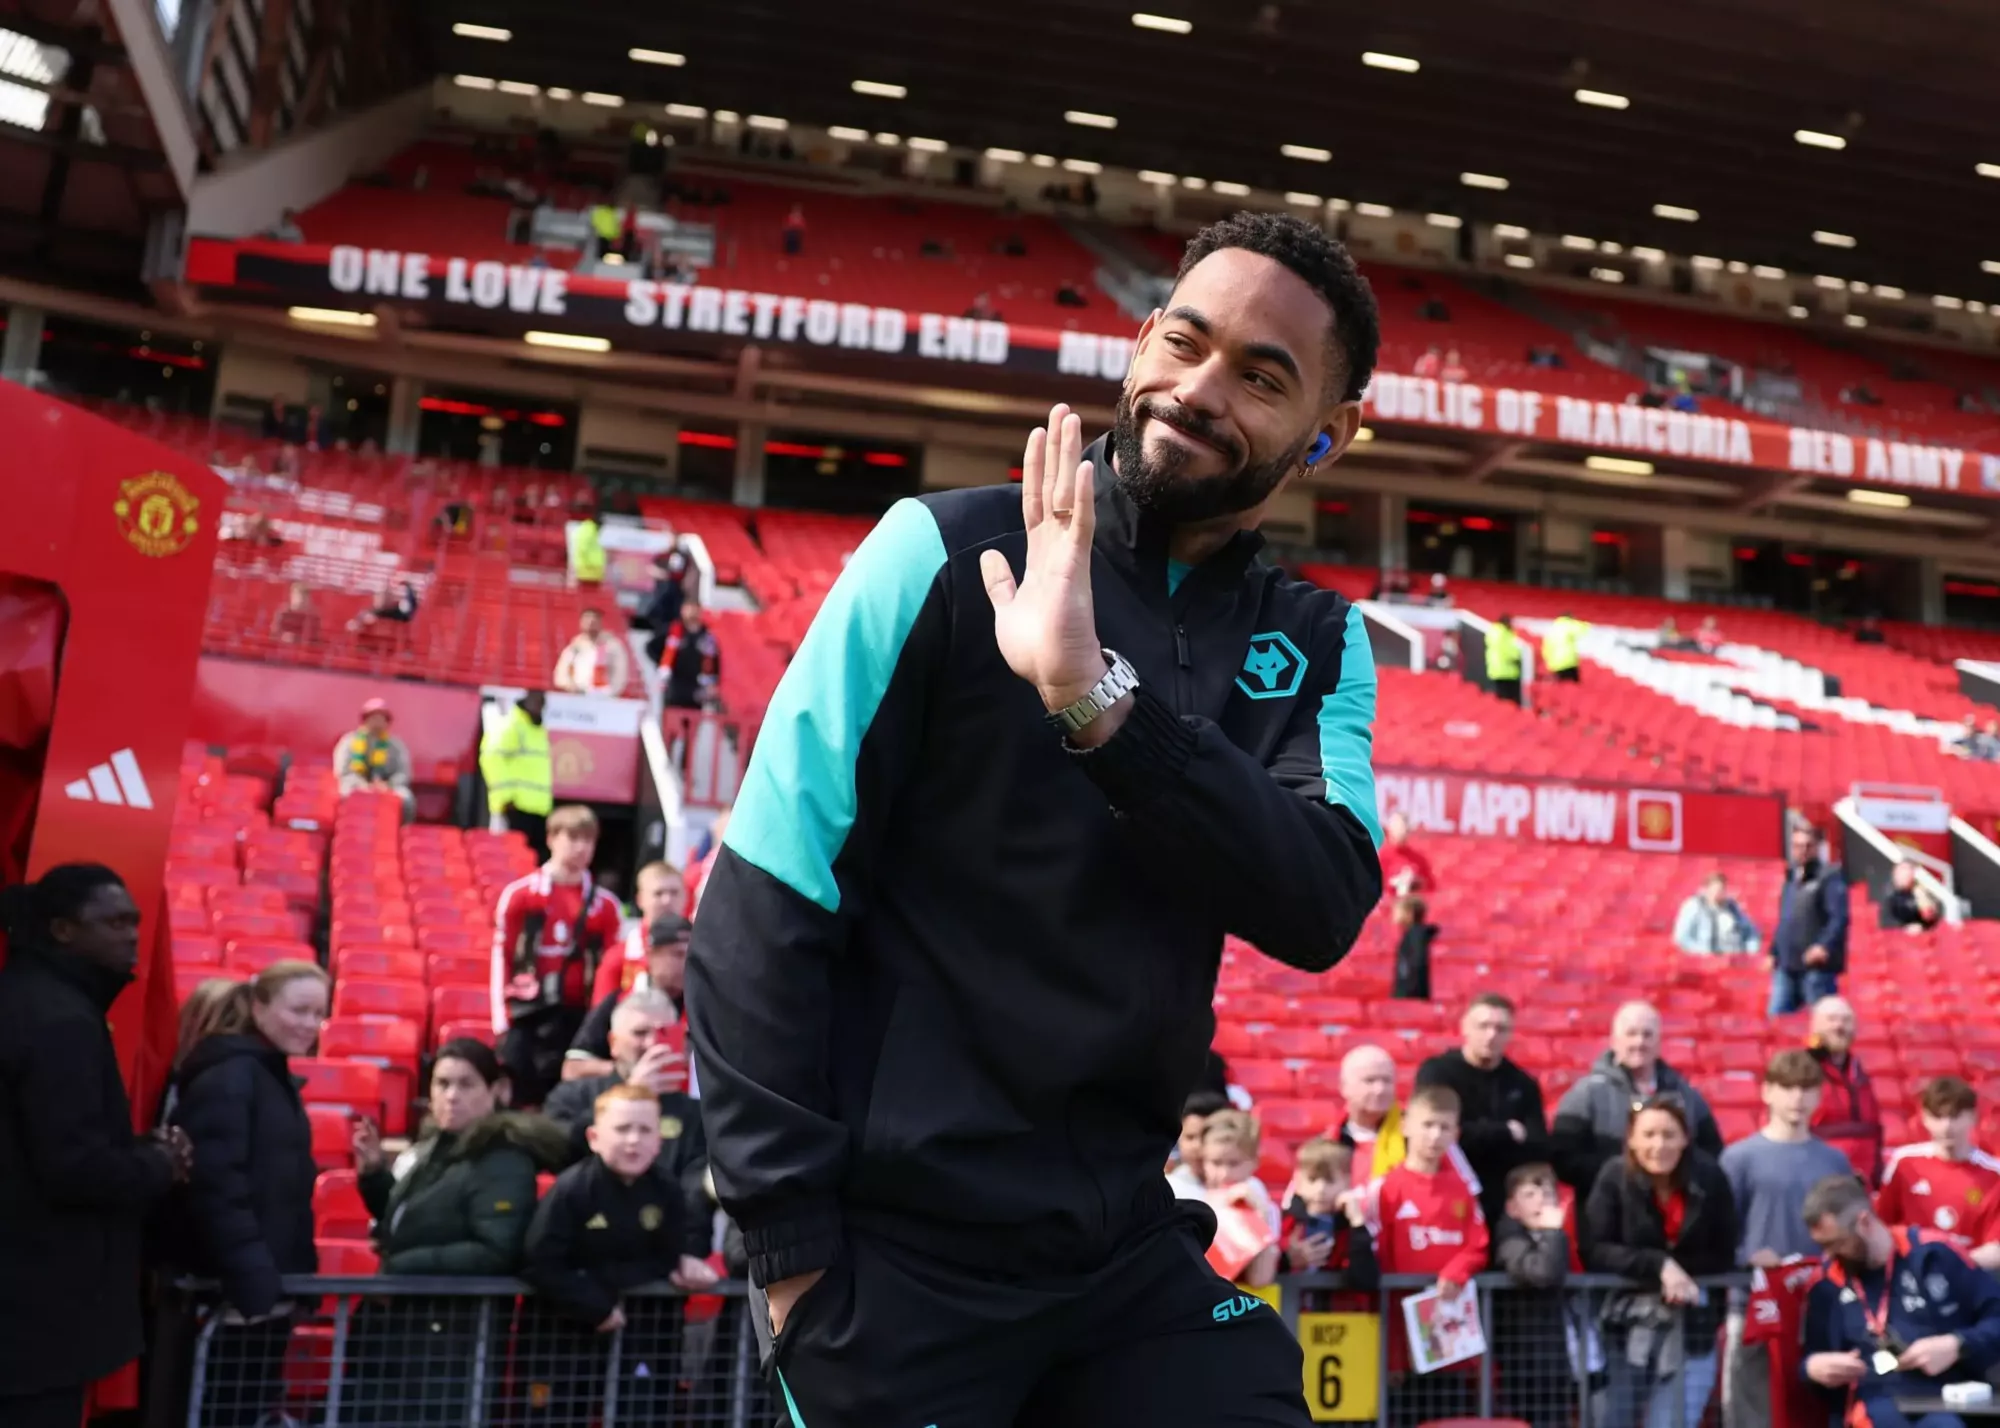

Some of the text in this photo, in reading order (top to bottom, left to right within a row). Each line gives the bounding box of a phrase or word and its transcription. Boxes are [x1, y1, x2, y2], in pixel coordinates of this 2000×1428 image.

[329, 245, 569, 315] ONE LOVE
[624, 279, 1009, 364] STRETFORD END
[1058, 331, 1134, 380] MU
[1496, 388, 1543, 435] OF
[1789, 427, 1963, 490] RED ARMY
[1459, 781, 1531, 838] APP
[1534, 787, 1617, 844] NOW
[1319, 1354, 1342, 1410] 6
